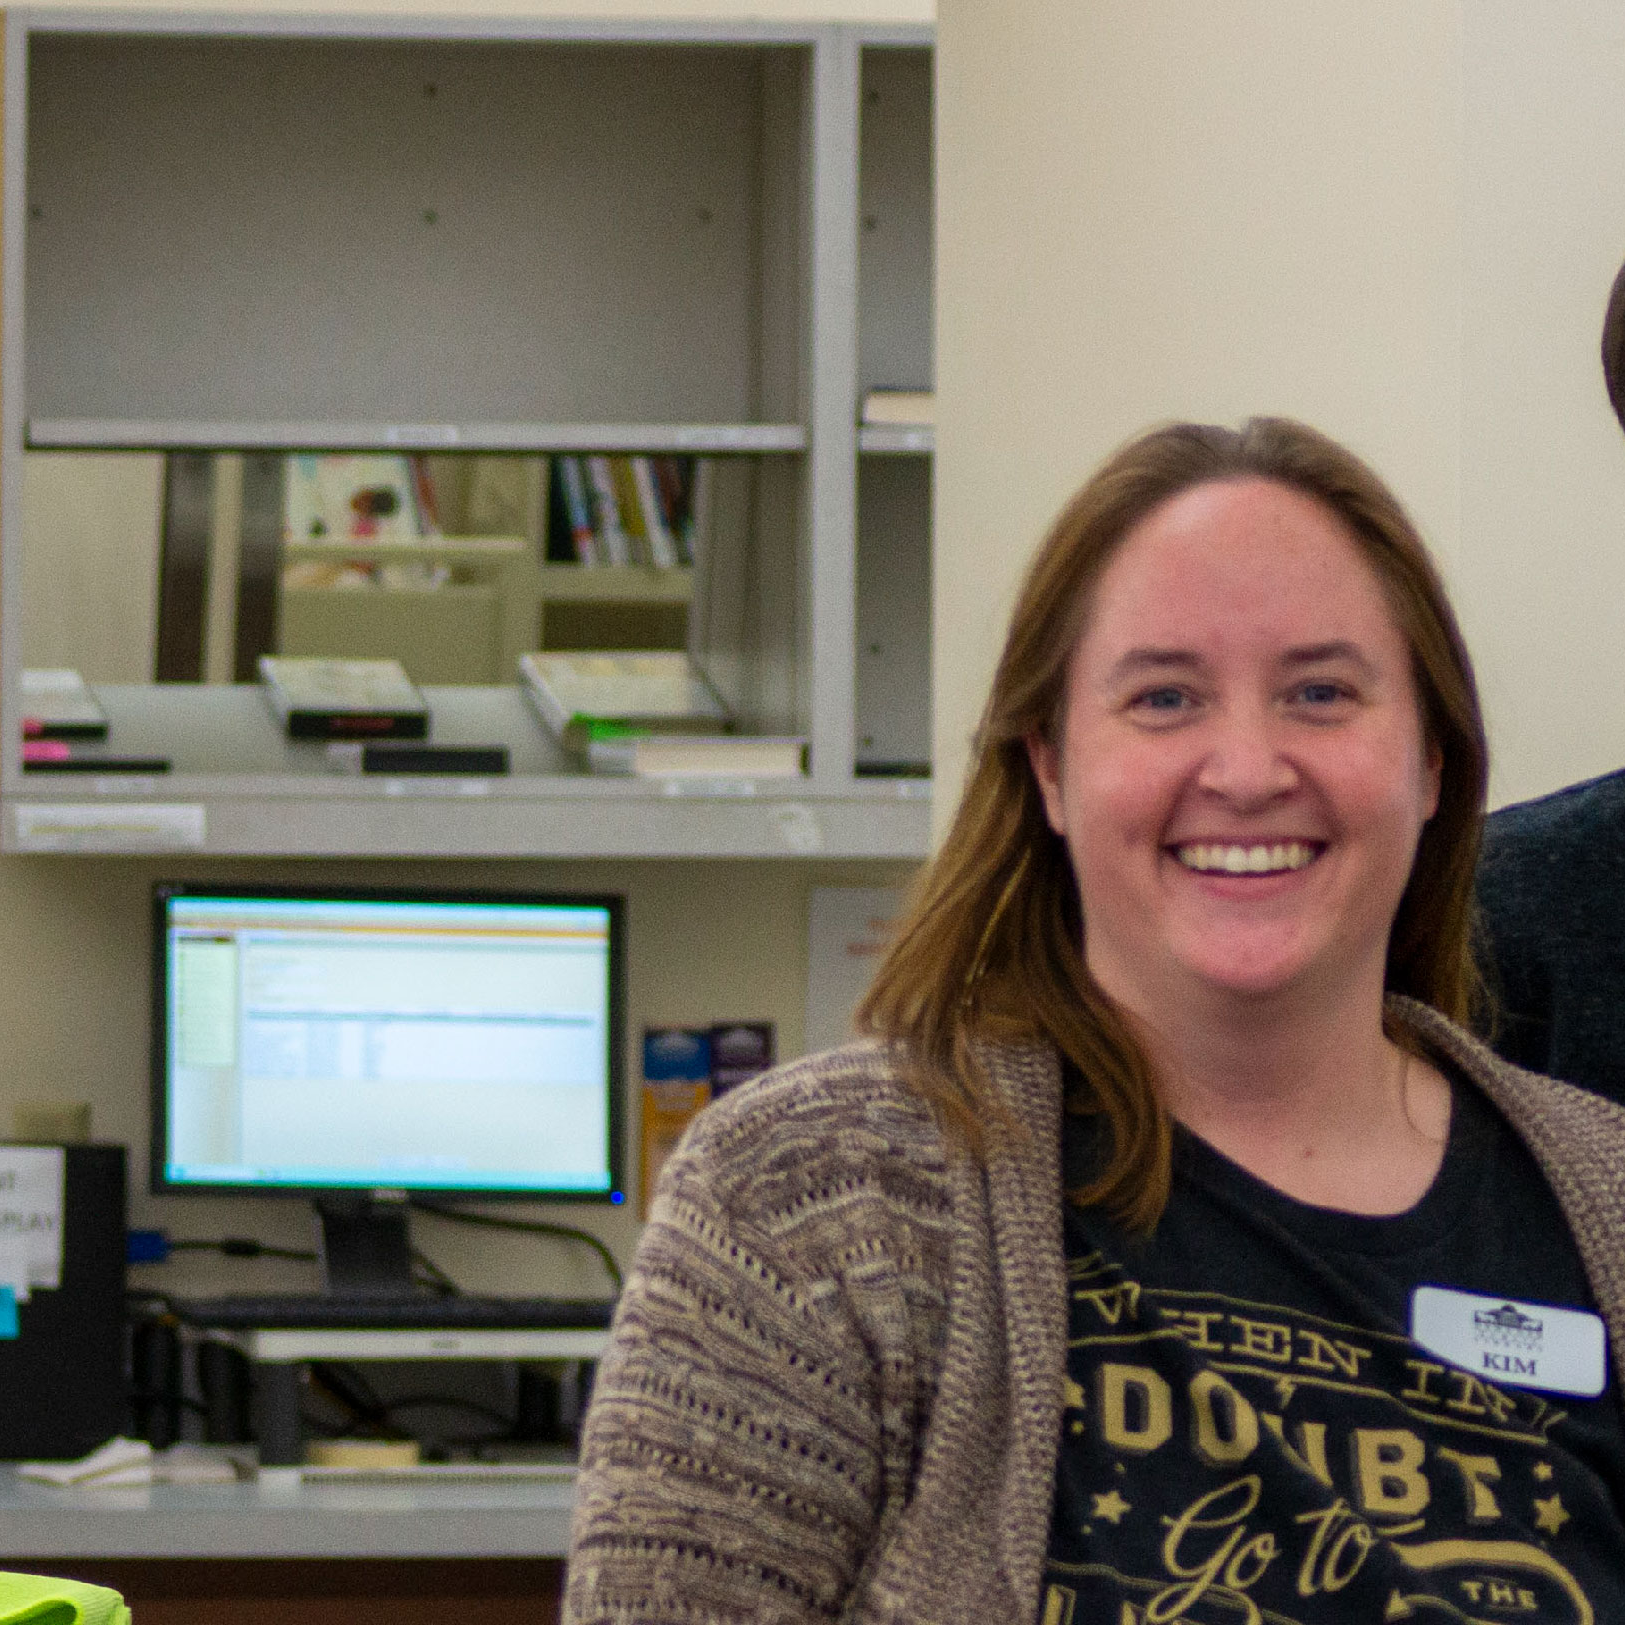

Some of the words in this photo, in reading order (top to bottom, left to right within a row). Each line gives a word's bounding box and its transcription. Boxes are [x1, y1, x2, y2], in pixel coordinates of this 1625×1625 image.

[1482, 1351, 1537, 1376] KIM
[1095, 1362, 1504, 1523] DOUBT
[1145, 1473, 1281, 1625] Go
[1294, 1497, 1381, 1597] to
[1459, 1579, 1539, 1612] THE
